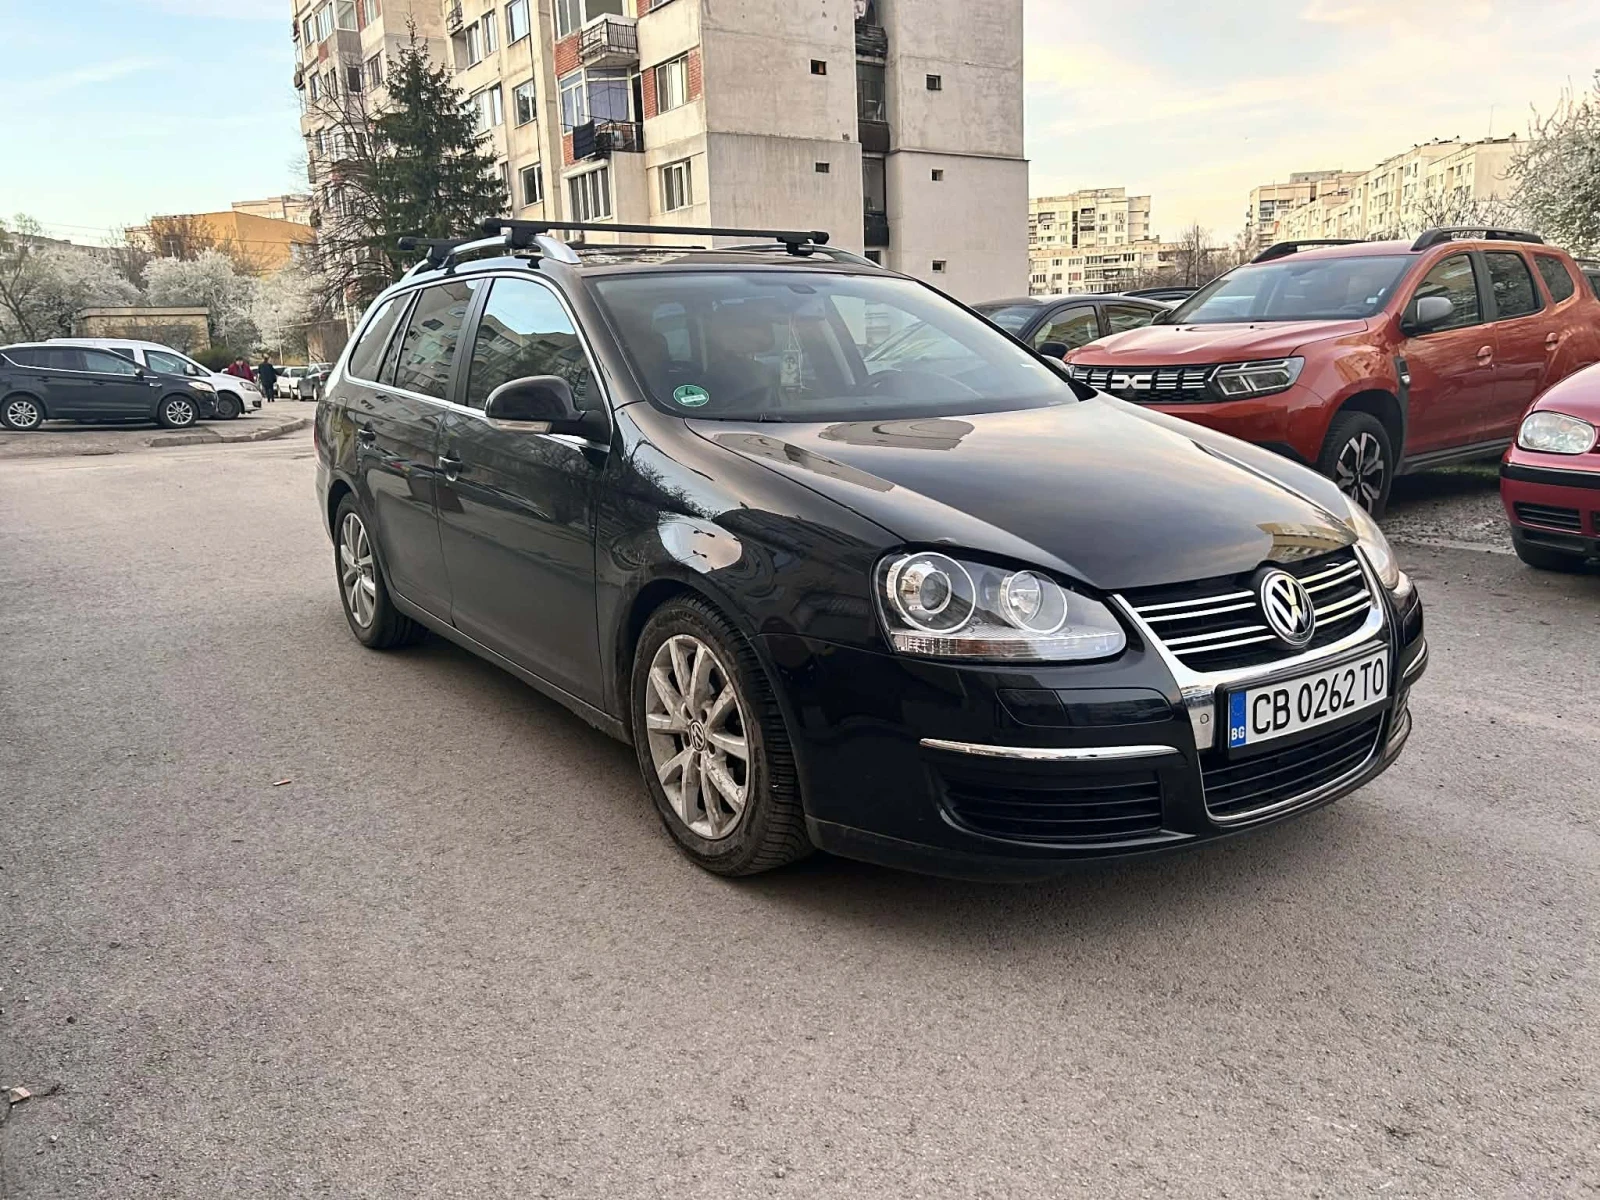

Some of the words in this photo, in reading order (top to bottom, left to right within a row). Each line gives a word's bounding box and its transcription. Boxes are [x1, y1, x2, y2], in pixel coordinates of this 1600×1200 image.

[1252, 688, 1290, 735] CB
[1298, 668, 1356, 723] 0262
[1360, 657, 1384, 701] TO
[1231, 726, 1245, 740] BG
